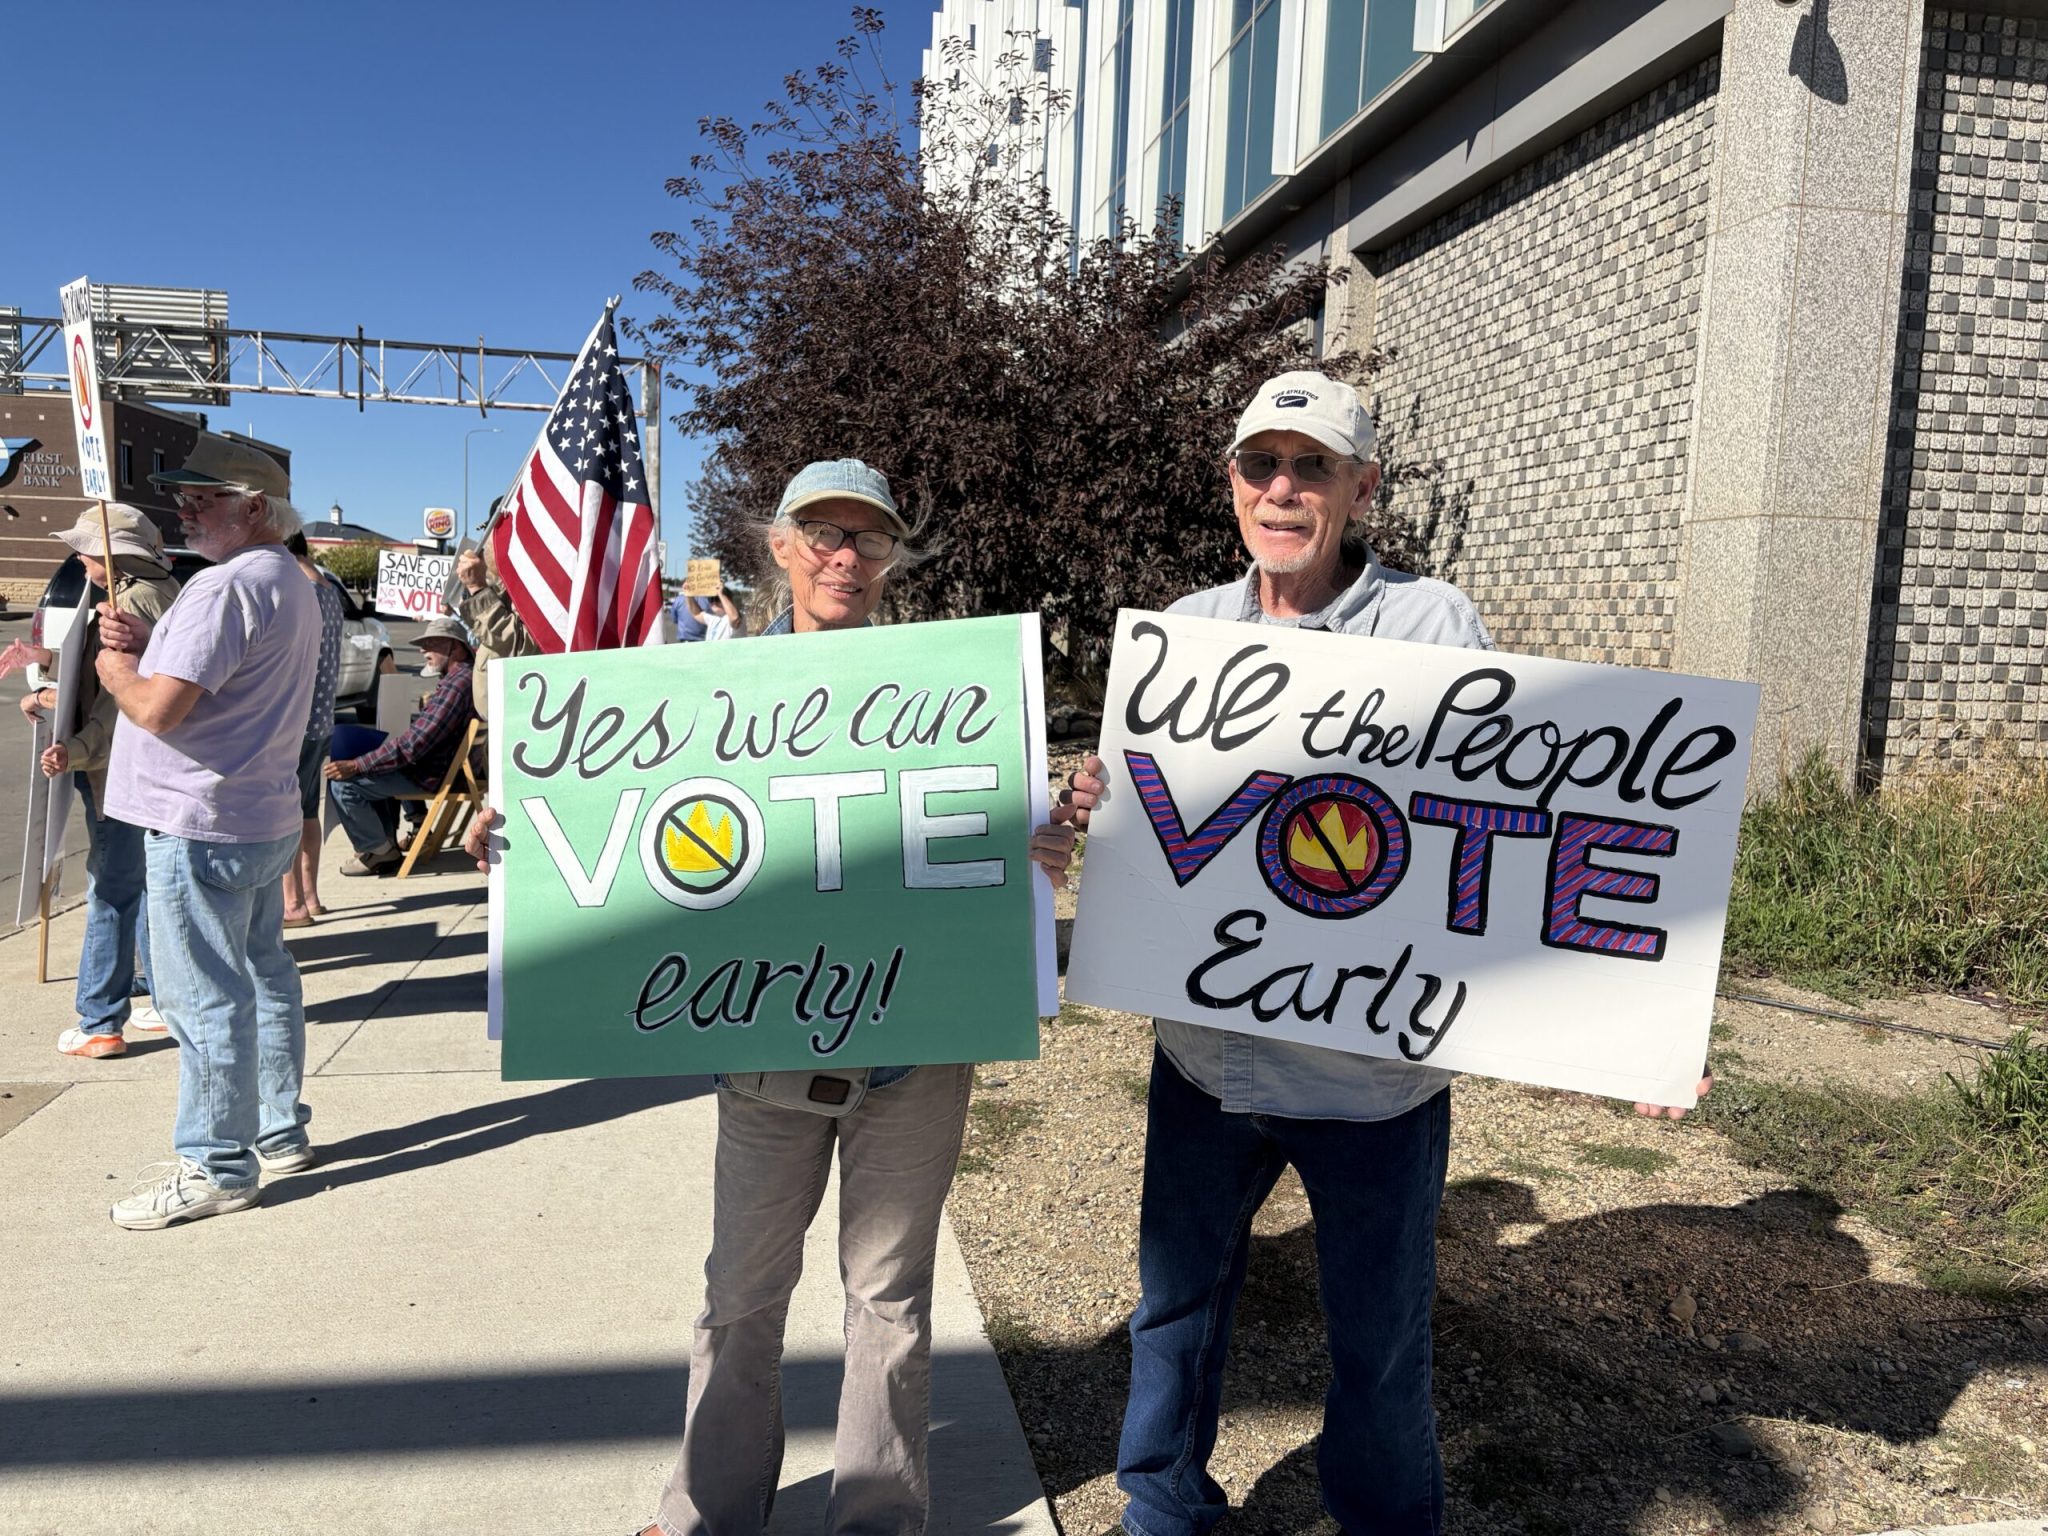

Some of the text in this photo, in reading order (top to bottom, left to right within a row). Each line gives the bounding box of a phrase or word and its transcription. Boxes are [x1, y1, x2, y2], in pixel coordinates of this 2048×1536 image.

[1286, 389, 1319, 400] ATHLETICS
[23, 452, 62, 464] FIRST
[82, 429, 102, 463] VOTE
[23, 464, 81, 477] NATION
[23, 475, 60, 487] BANK
[84, 468, 106, 496] EARLY
[430, 519, 451, 529] KING
[386, 553, 451, 577] SAVE OU
[380, 568, 448, 593] DEMOCRA
[380, 586, 396, 598] NO
[512, 672, 1005, 778] Yes we can
[1126, 622, 1736, 810] We the People
[520, 765, 1006, 911] VOTE
[1123, 750, 1679, 961] VOTE
[1185, 909, 1466, 1061] Early
[624, 943, 905, 1056] early!
